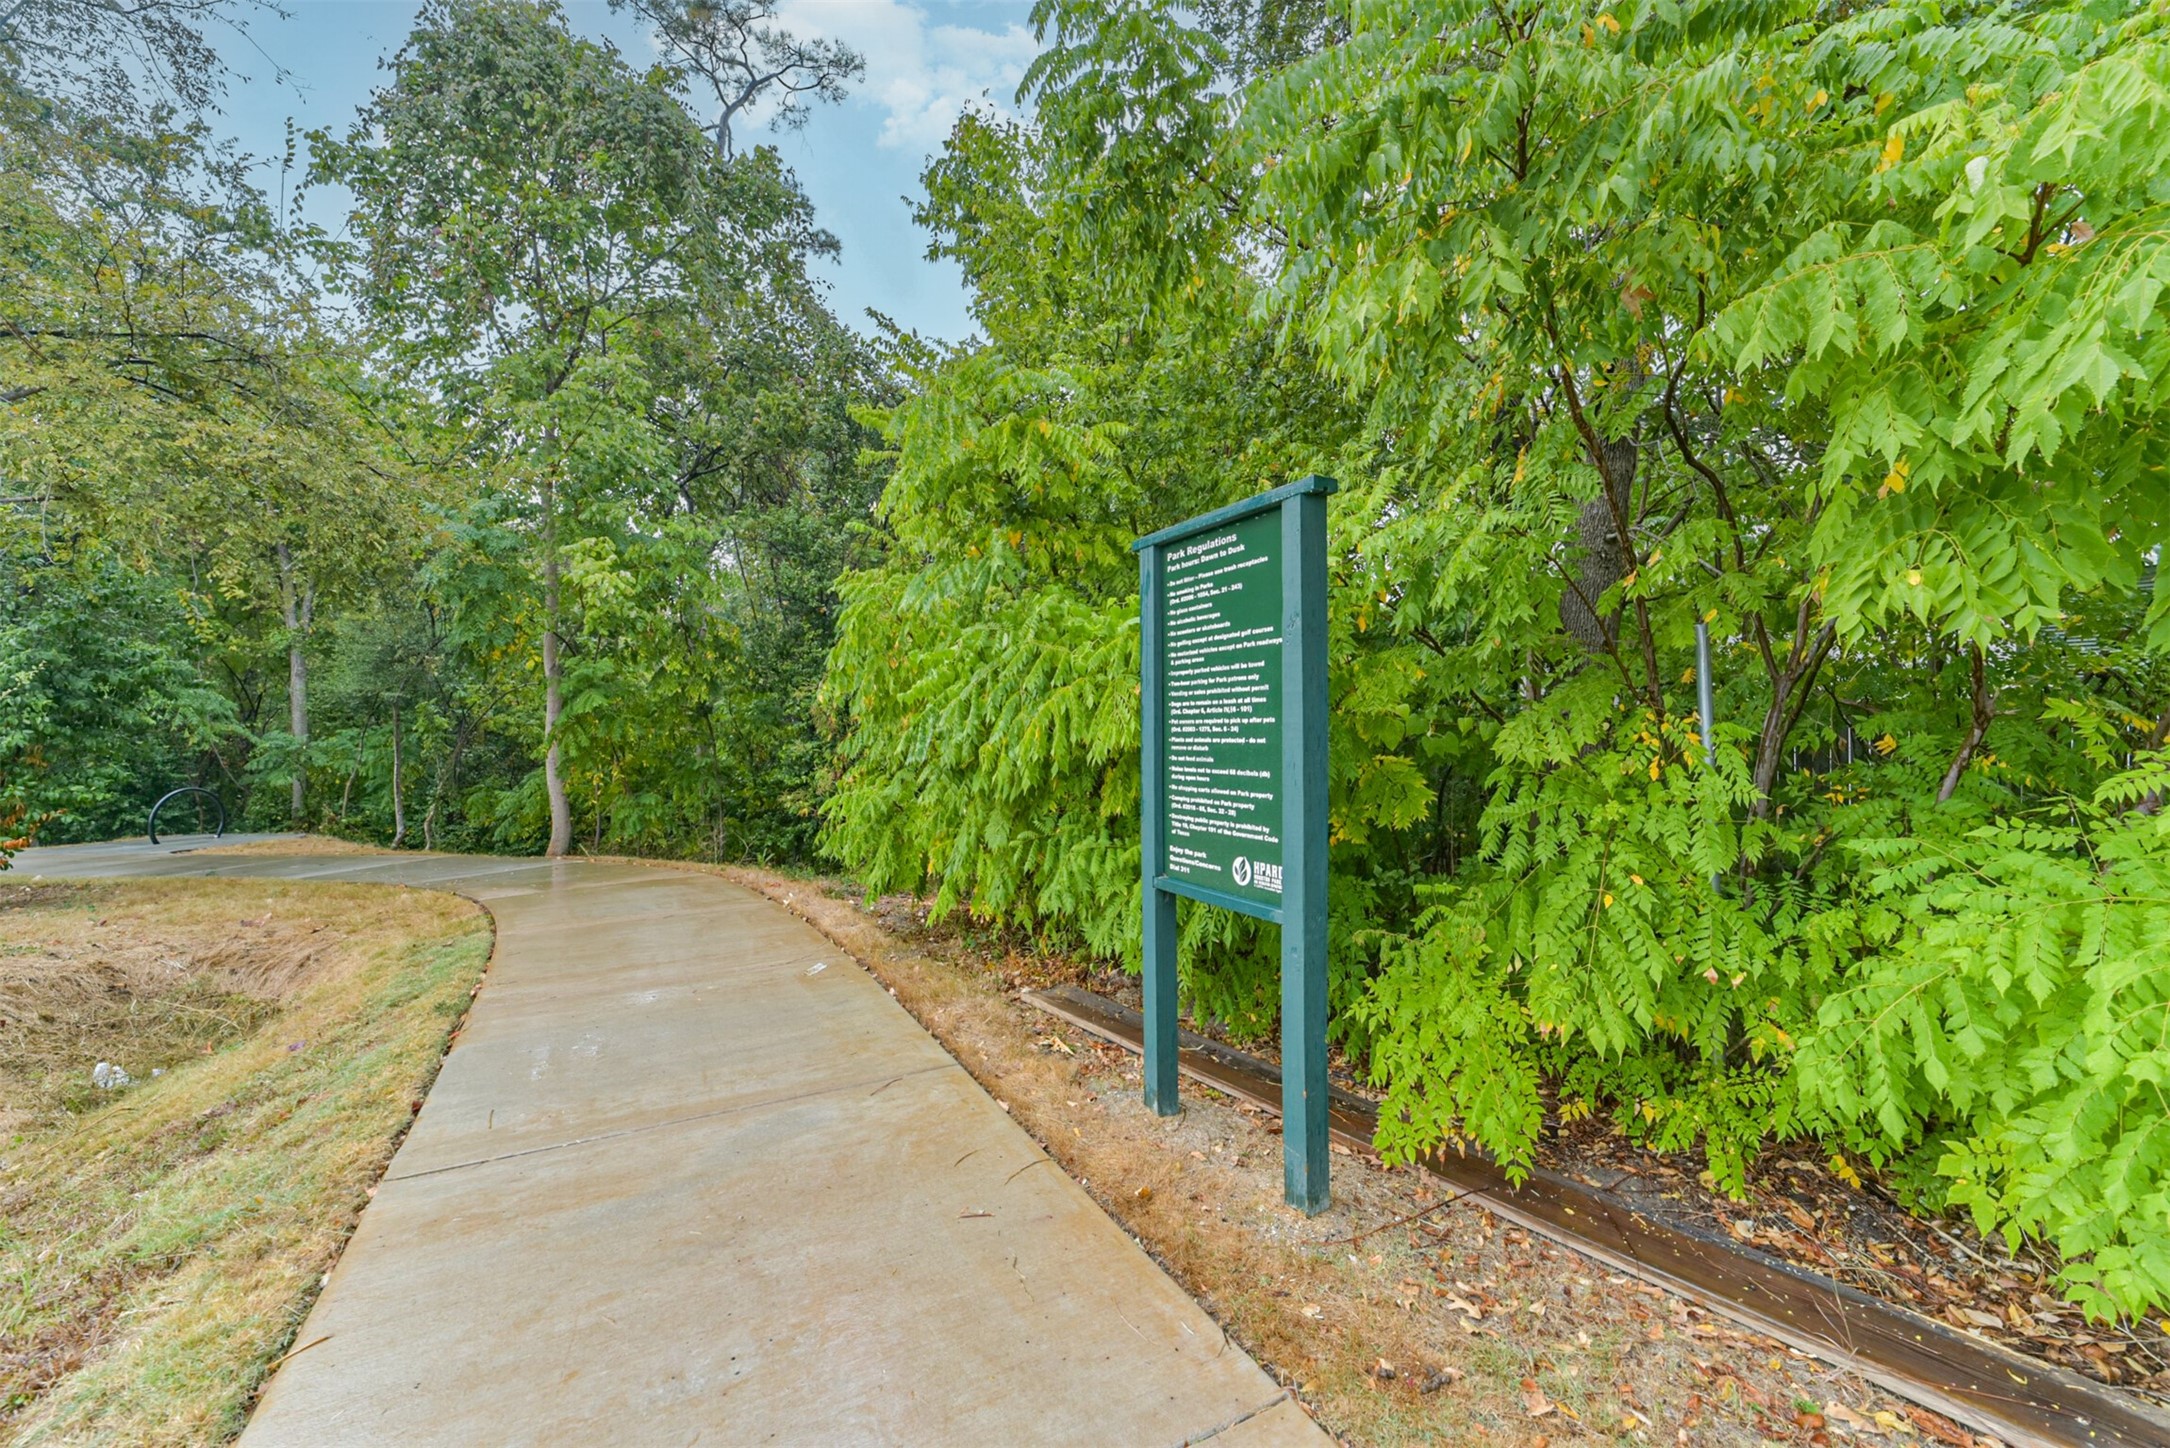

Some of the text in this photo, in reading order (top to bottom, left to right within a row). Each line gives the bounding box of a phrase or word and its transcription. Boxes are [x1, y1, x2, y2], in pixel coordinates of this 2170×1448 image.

[1167, 533, 1237, 562] Park Regulations
[1167, 563, 1181, 573] Park
[1200, 552, 1219, 563] Dawn
[1227, 543, 1245, 555] Dusk
[1198, 571, 1214, 579] Please
[1223, 564, 1237, 573] trash
[1237, 556, 1269, 569] receptacles
[1200, 582, 1214, 590] Parks
[1176, 607, 1188, 616] glass
[1188, 602, 1213, 612] containers
[1176, 616, 1196, 625] alcoholic
[1196, 612, 1221, 621] beverages
[1201, 621, 1231, 632] skateboards
[1191, 636, 1208, 644] except
[1213, 630, 1241, 641] designated
[1240, 628, 1252, 638] golf
[1252, 626, 1274, 635] courses
[1199, 646, 1218, 654] vehicles
[1218, 643, 1235, 652] except
[1243, 640, 1256, 648] Park
[1256, 637, 1284, 646] roadways
[1174, 658, 1192, 666] parking
[1194, 666, 1210, 675] parked
[1210, 664, 1230, 672] vehicles
[1248, 660, 1265, 668] towed
[1190, 678, 1208, 686] parking
[1227, 675, 1247, 683] patrons
[1247, 673, 1260, 681] only
[1206, 687, 1231, 696] prohibited
[1231, 685, 1251, 693] without
[1251, 684, 1270, 693] permit
[1243, 696, 1251, 704] all
[1206, 706, 1223, 714] Article
[1229, 717, 1241, 725] pick
[1249, 716, 1263, 724] after
[1262, 716, 1276, 724] pets
[1171, 773, 1185, 781] during
[1236, 769, 1259, 777] decibels
[1210, 787, 1230, 795] allowed
[1237, 789, 1250, 797] Park
[1250, 792, 1274, 801] property
[1190, 797, 1214, 805] prohibited
[1220, 799, 1232, 807] Park
[1232, 802, 1255, 811] property
[1171, 820, 1182, 828] Title
[1189, 823, 1208, 832] Chapter
[1223, 828, 1232, 836] the
[1232, 829, 1264, 841] Government
[1263, 834, 1279, 844] Code
[1177, 828, 1190, 837] Texas
[1209, 819, 1230, 828] property
[1235, 823, 1262, 832] prohibited
[1262, 825, 1270, 834] by
[1169, 844, 1207, 859] Enjoy the park
[1169, 854, 1222, 872] Questions/Concerns
[1169, 863, 1180, 872] Dial
